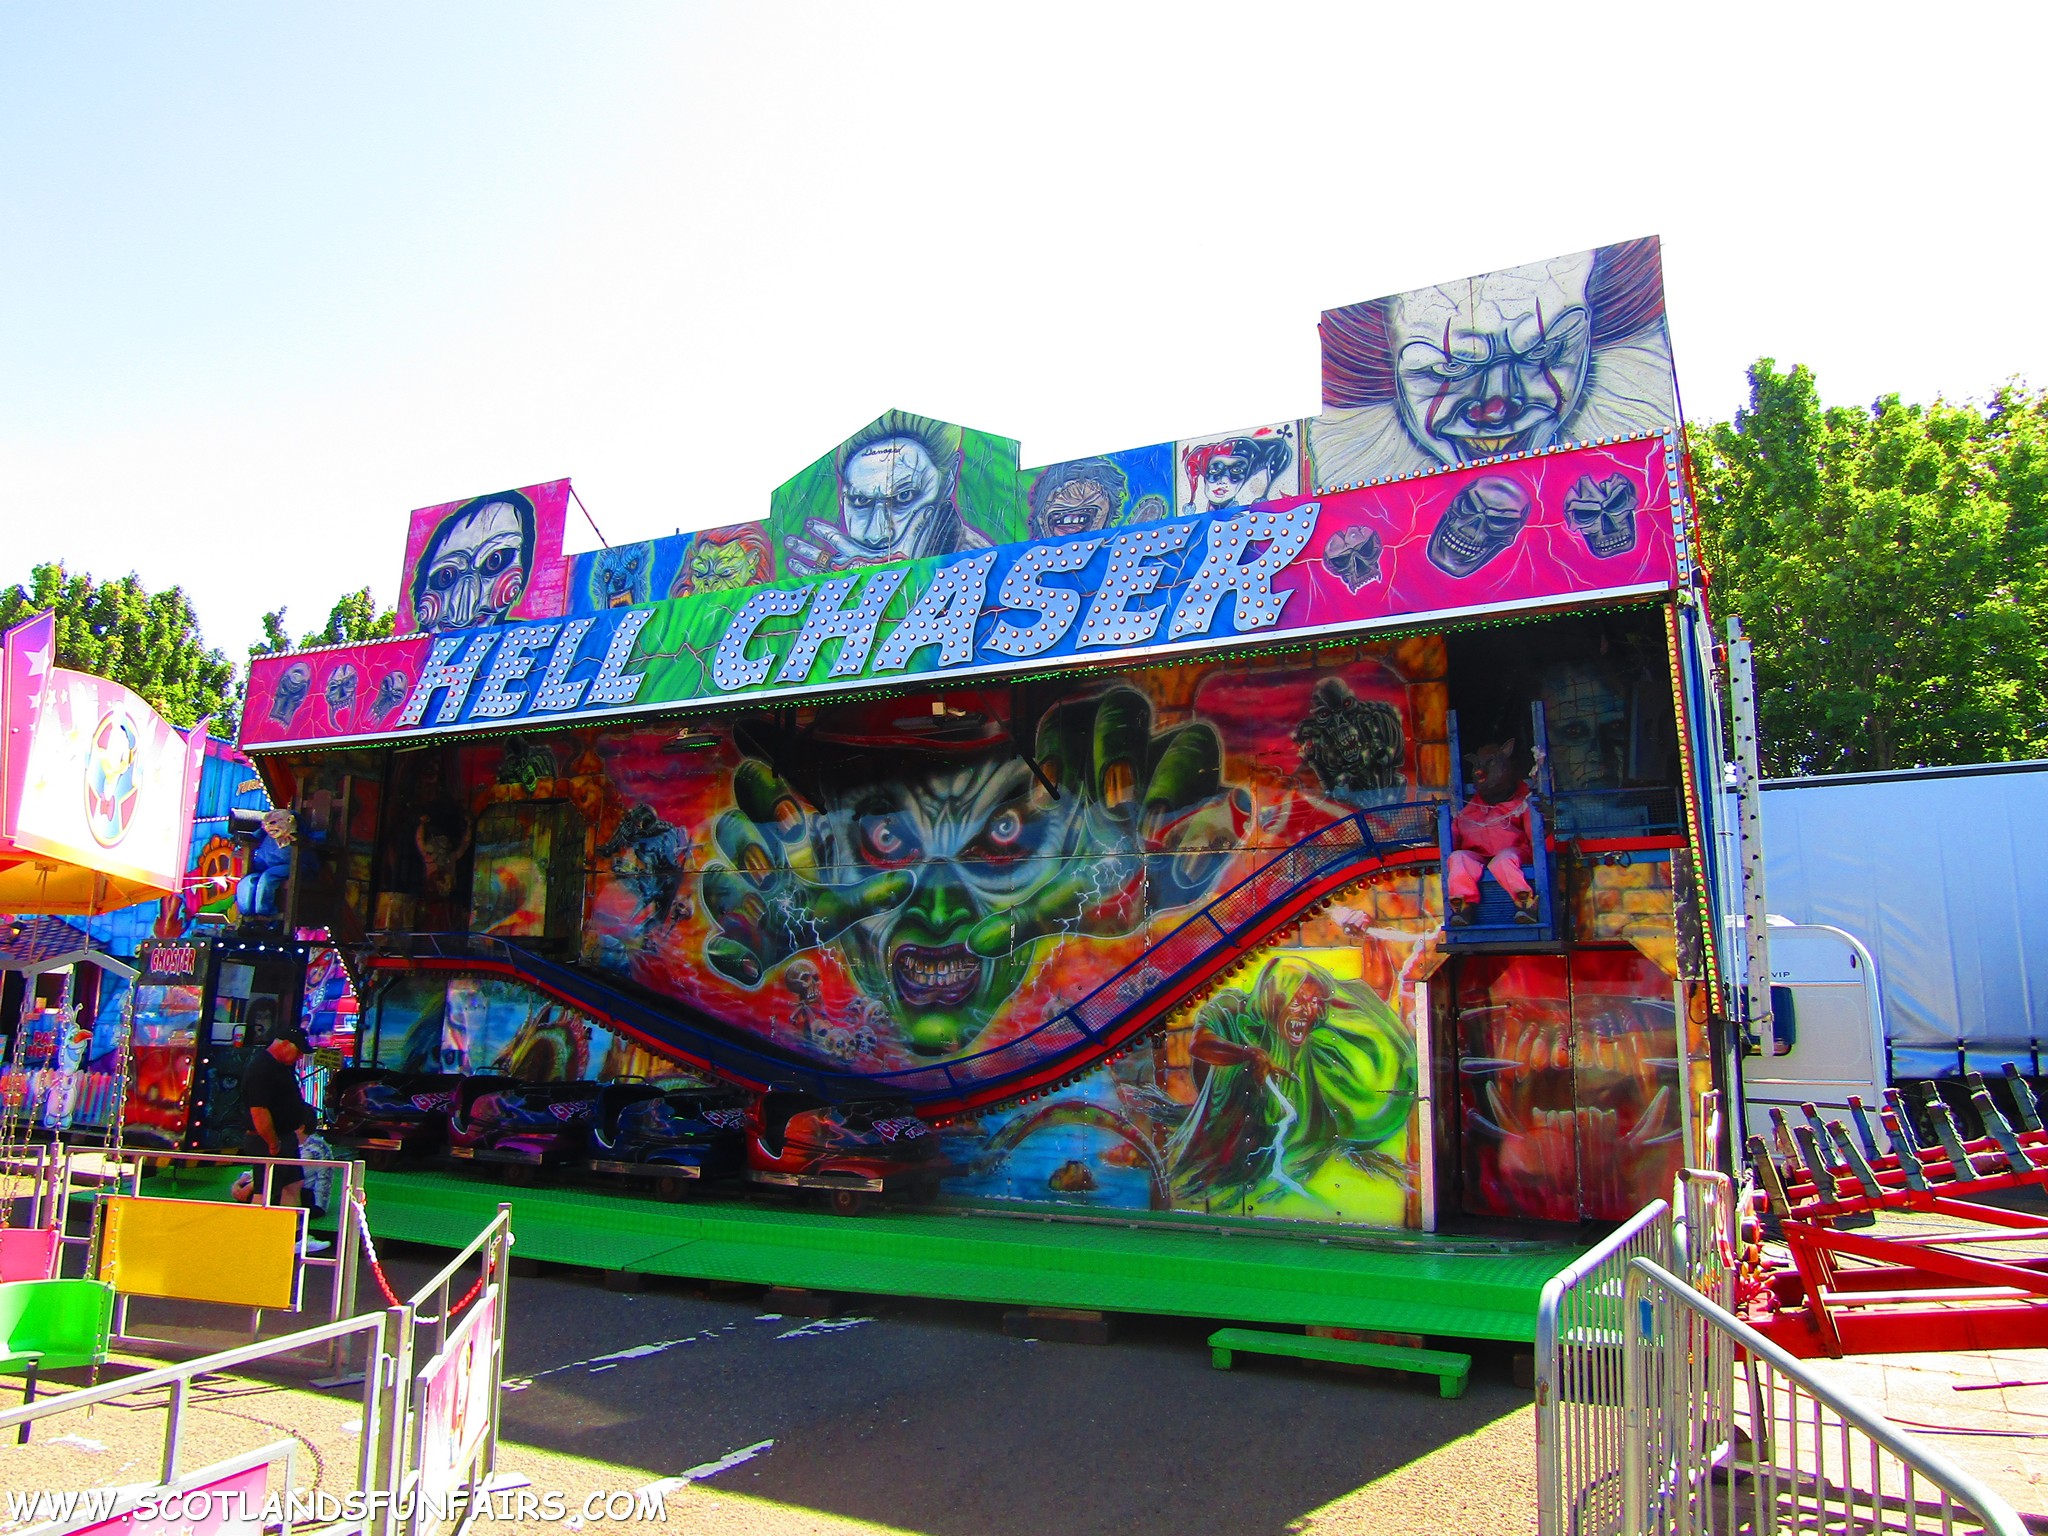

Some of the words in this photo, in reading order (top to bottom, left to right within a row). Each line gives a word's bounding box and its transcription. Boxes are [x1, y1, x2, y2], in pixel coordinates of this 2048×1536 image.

[395, 608, 656, 727] HELL
[714, 502, 1321, 691] CHASER
[151, 947, 197, 976] GHOSTER
